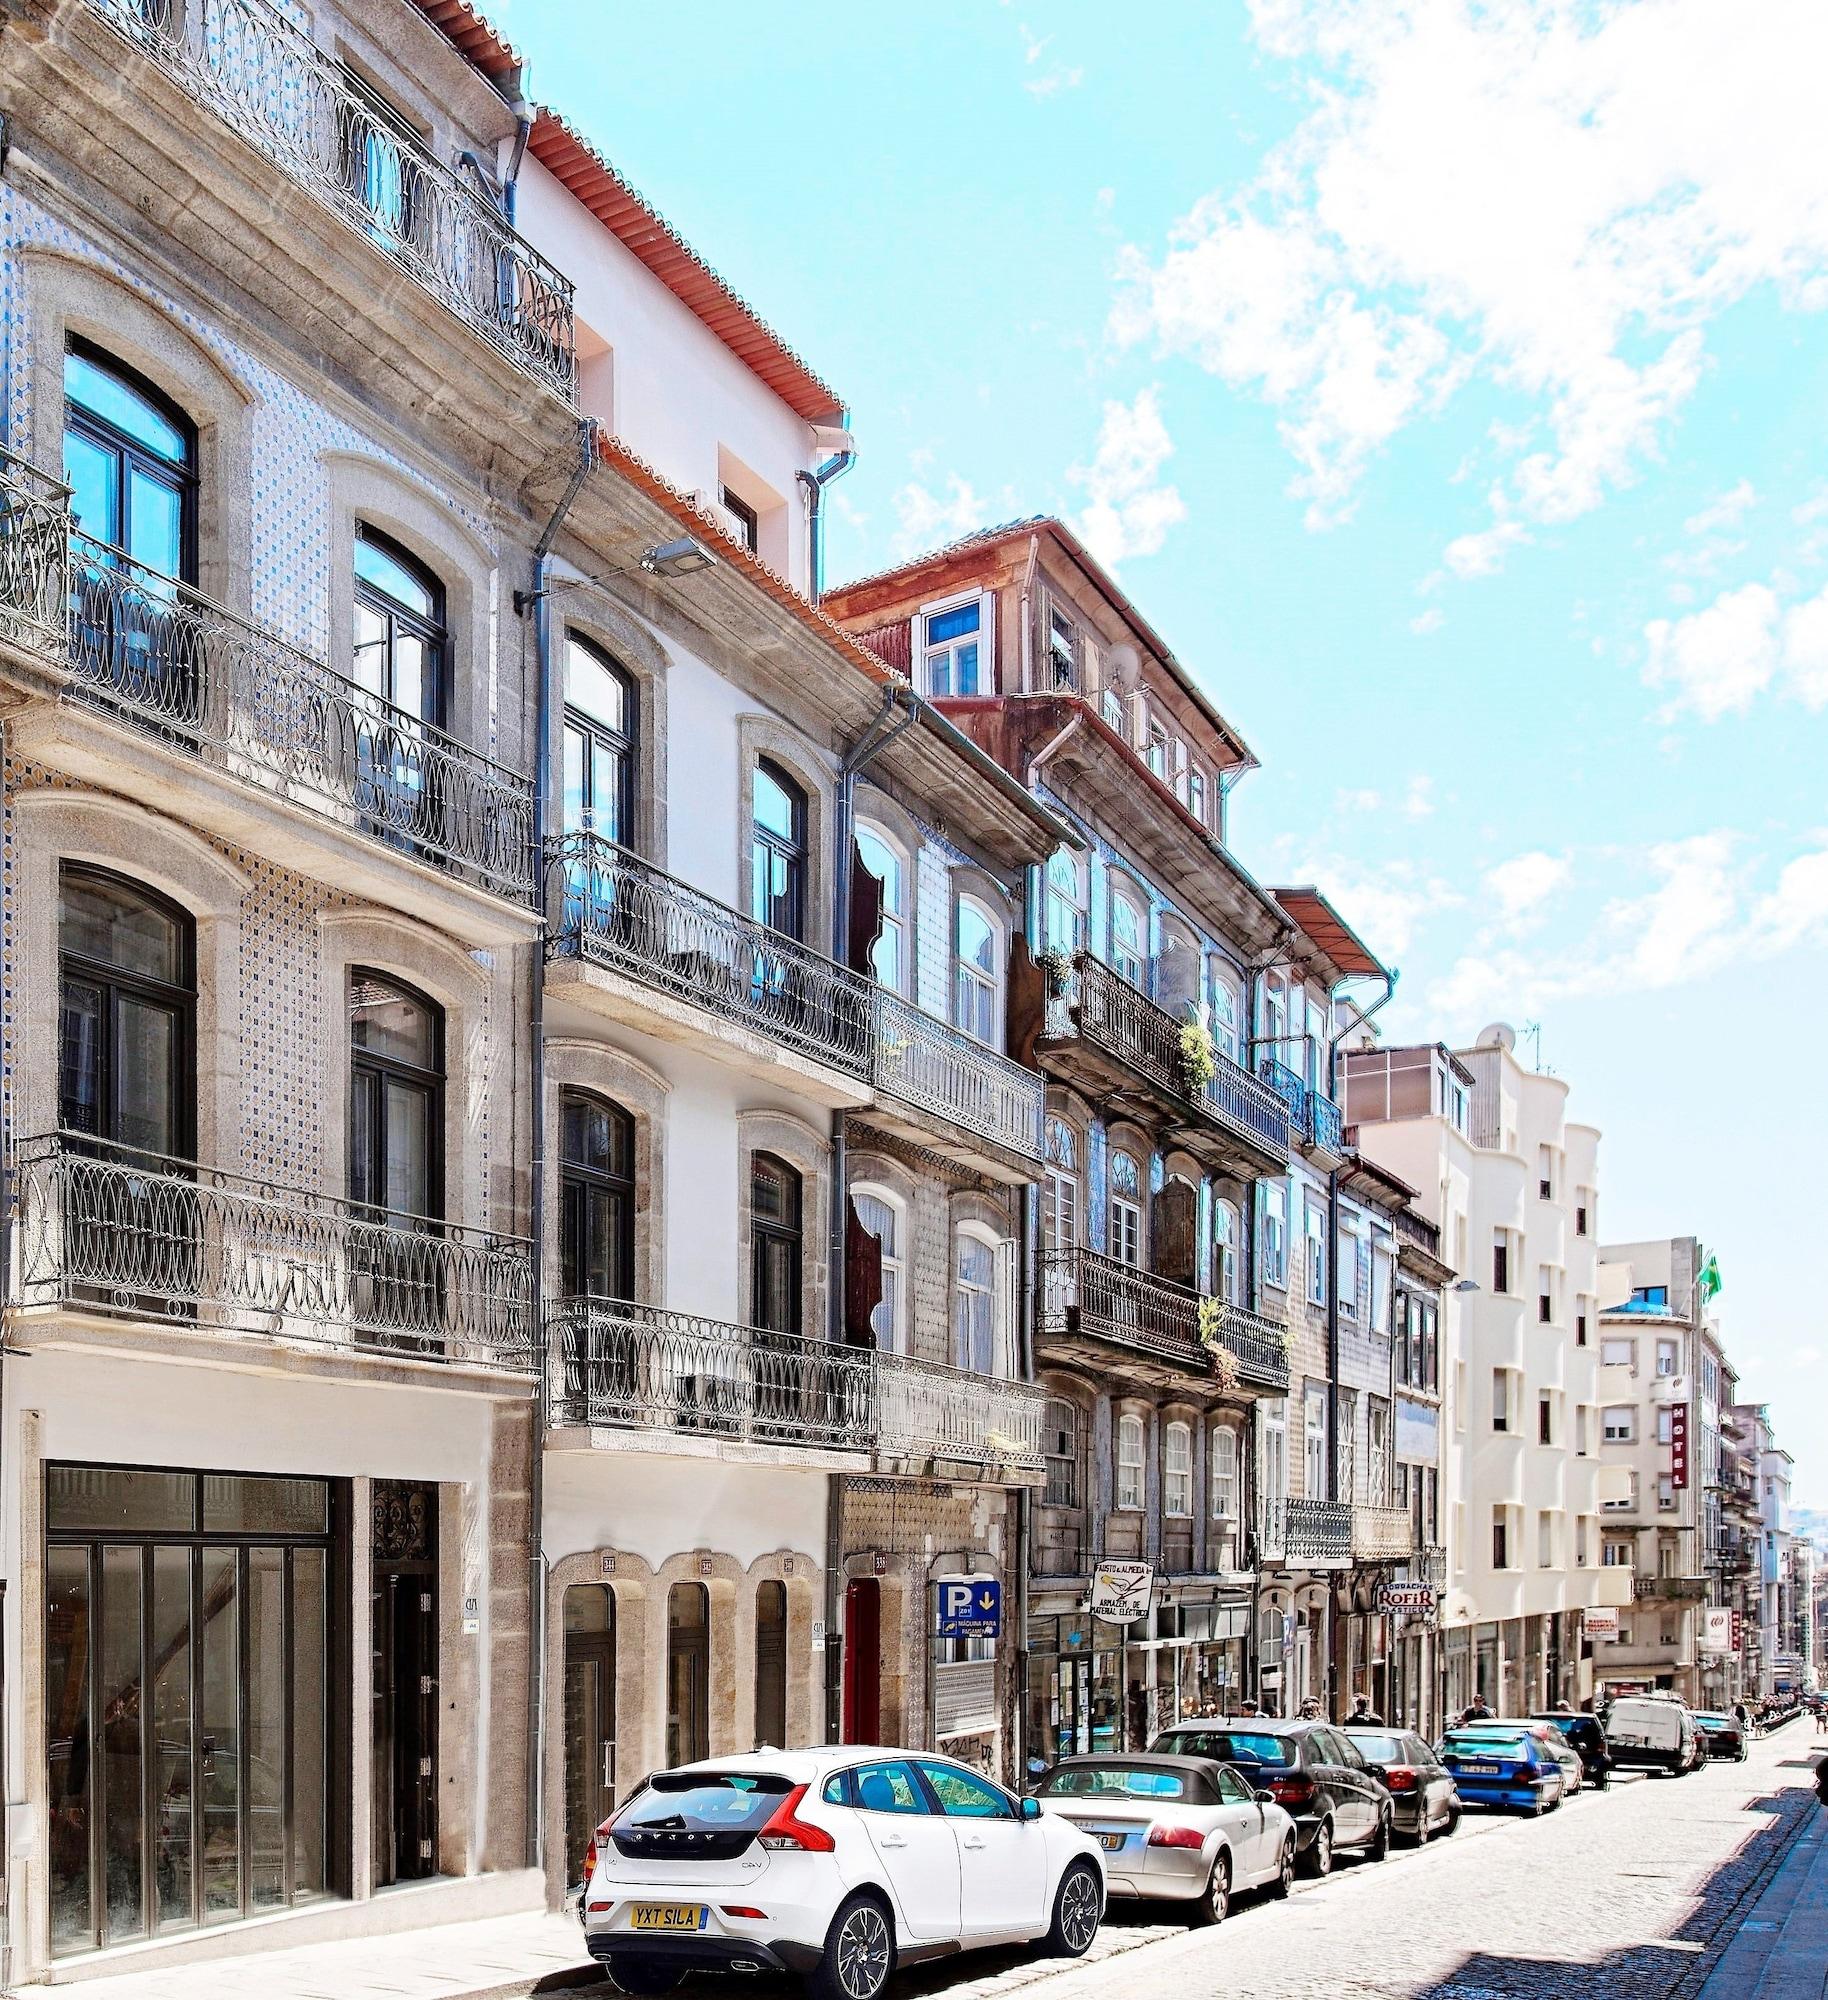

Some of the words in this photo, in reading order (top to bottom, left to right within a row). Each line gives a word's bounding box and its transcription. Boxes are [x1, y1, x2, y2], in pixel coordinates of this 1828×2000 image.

[1673, 1408, 1684, 1485] HOTEL
[1096, 1565, 1117, 1573] FAUSTO
[948, 1586, 973, 1617] P
[1100, 1599, 1128, 1608] ARMAZEM
[1133, 1600, 1141, 1609] DE
